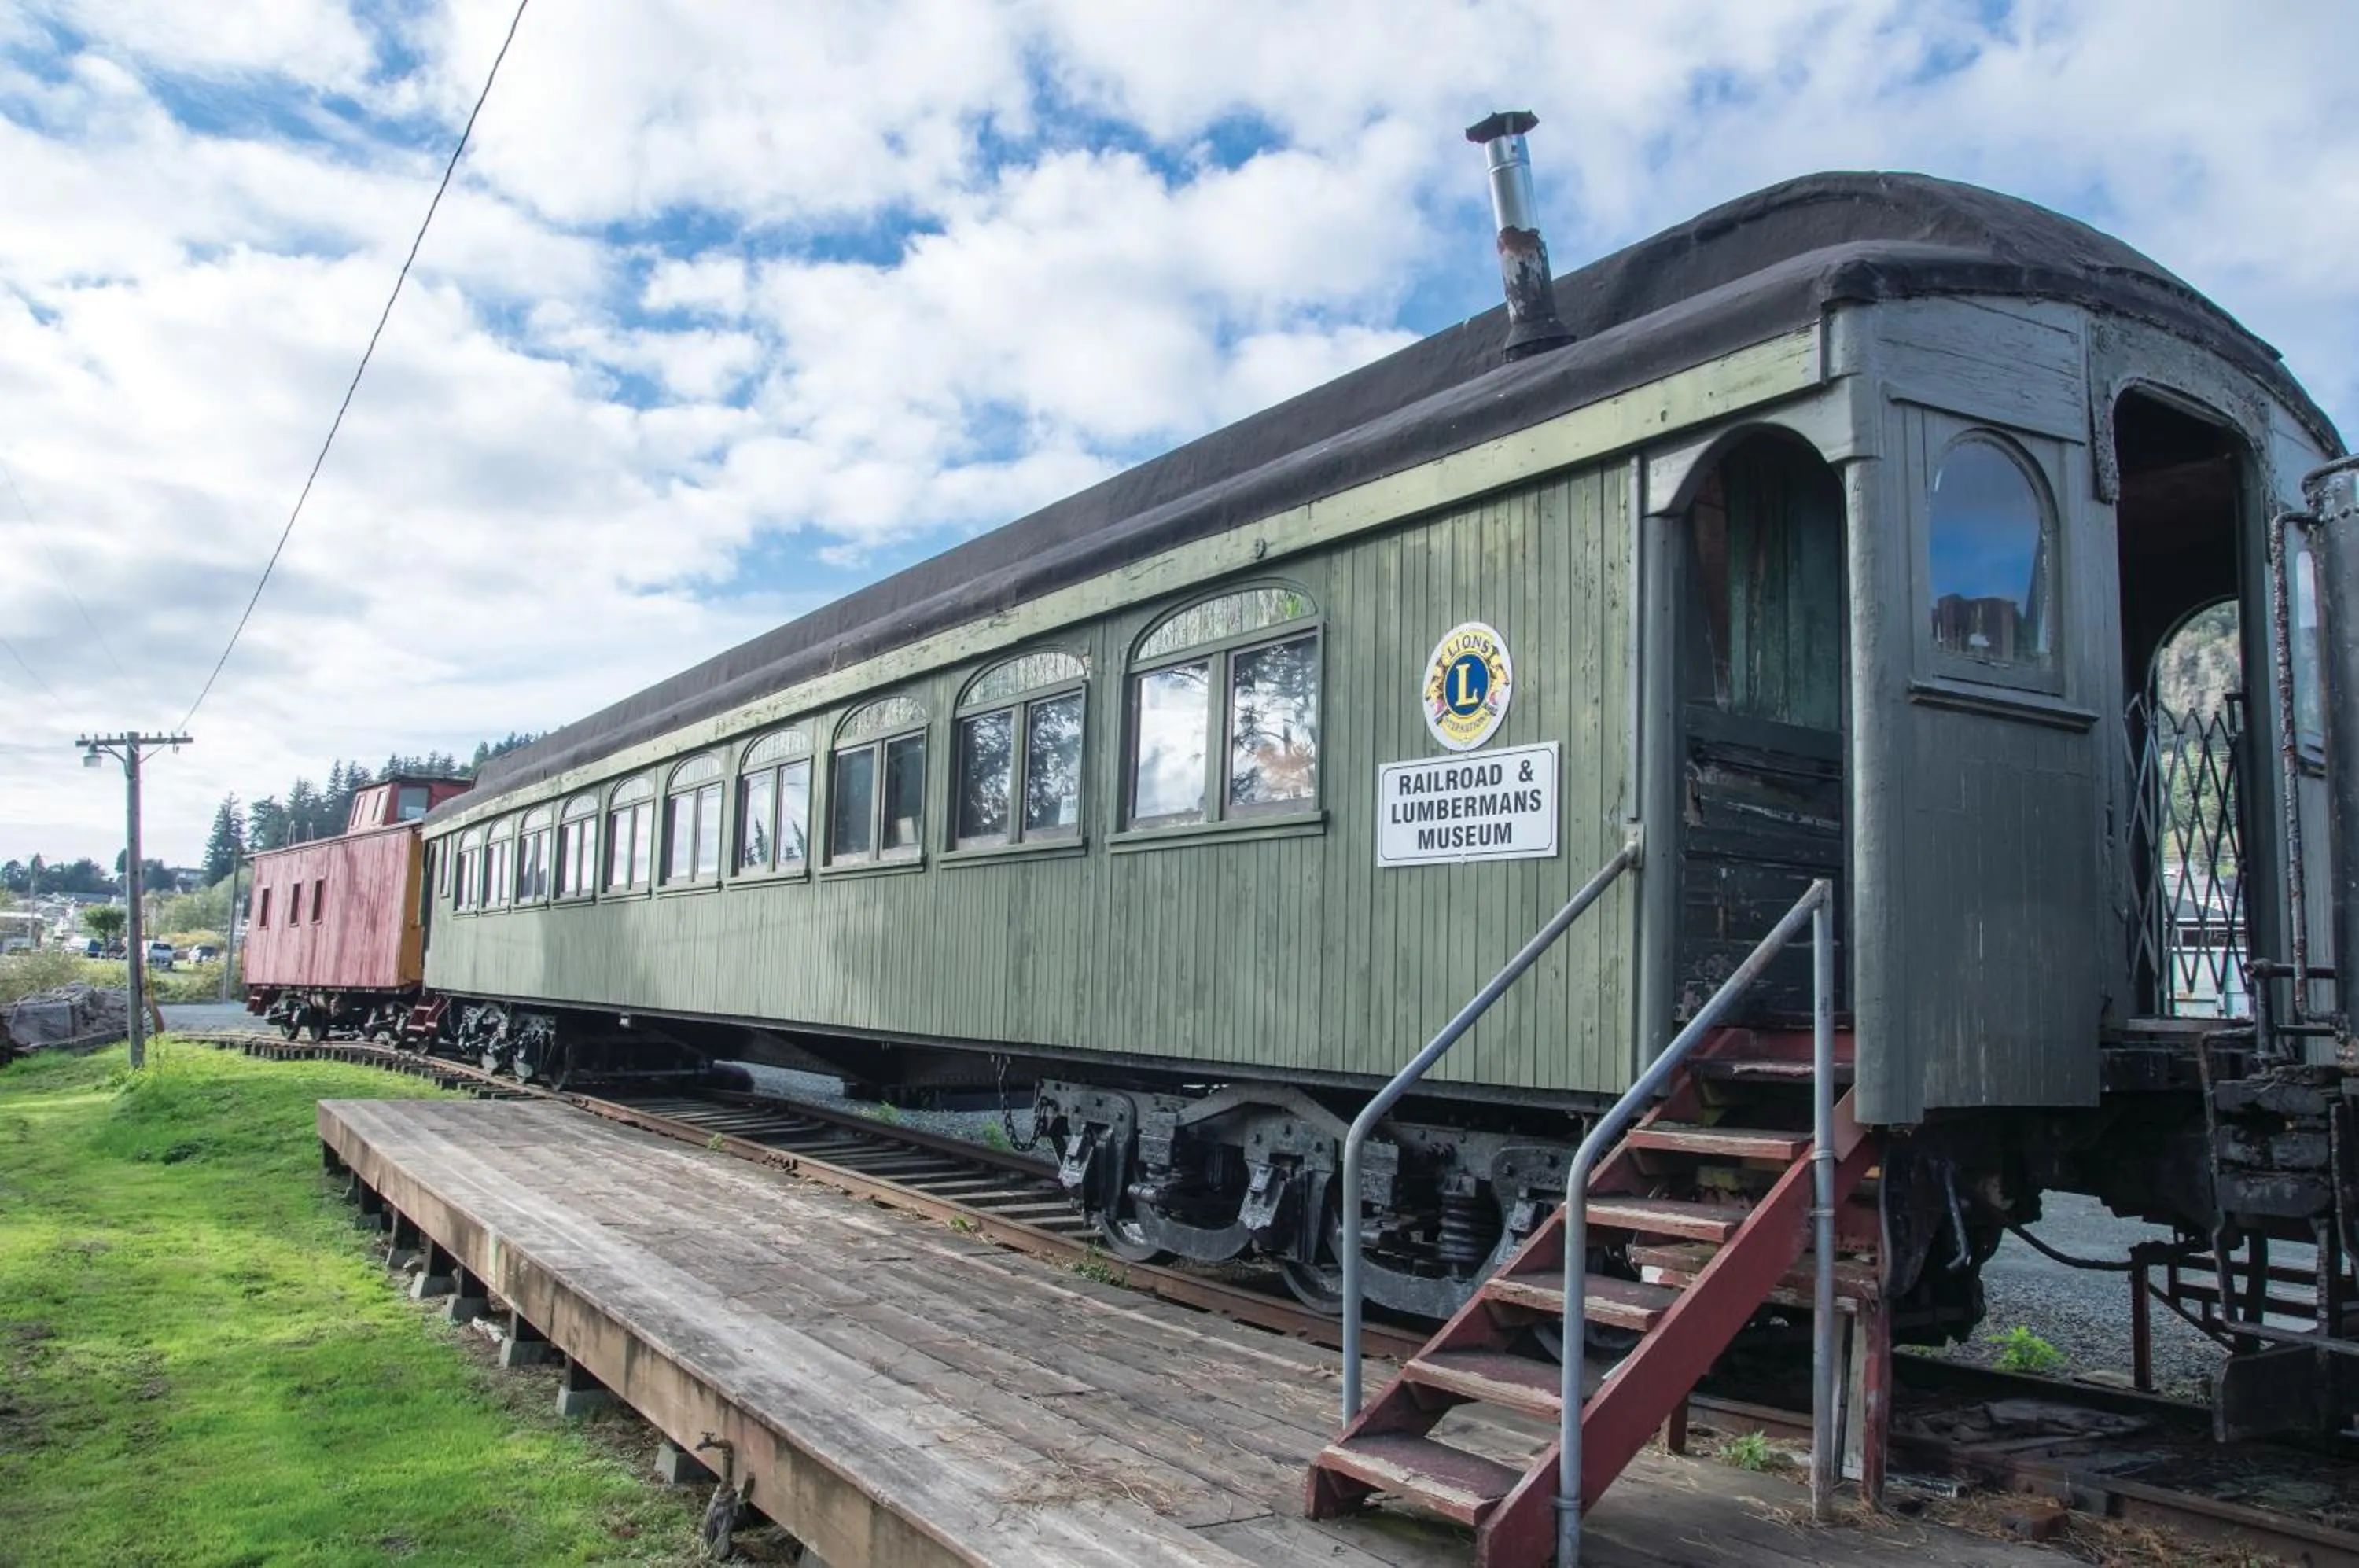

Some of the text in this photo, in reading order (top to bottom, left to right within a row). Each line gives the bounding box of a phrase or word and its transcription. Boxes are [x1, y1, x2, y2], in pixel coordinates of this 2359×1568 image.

[1448, 635, 1489, 657] LIONS
[1456, 664, 1479, 705] L
[1399, 759, 1533, 796] RAILROAD &
[1391, 789, 1542, 824] LUMBERMANS
[1418, 822, 1512, 850] MUSEUM
